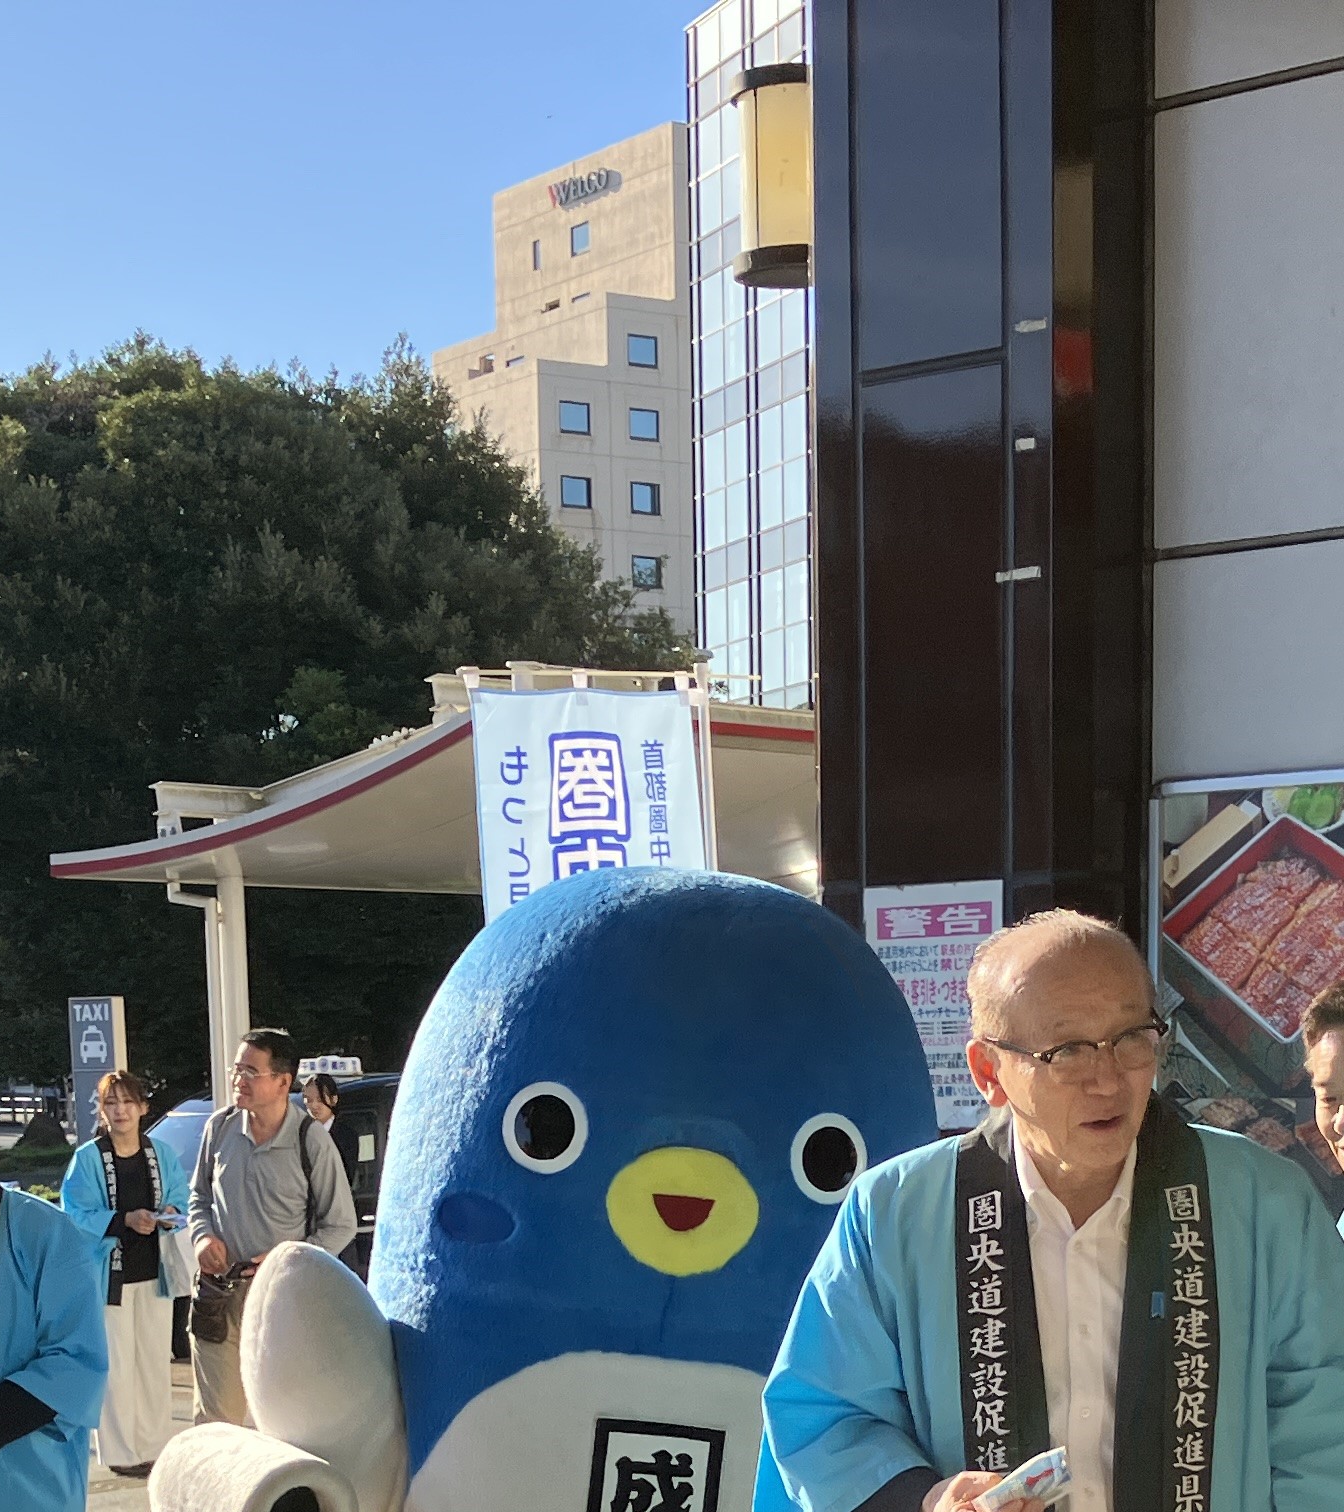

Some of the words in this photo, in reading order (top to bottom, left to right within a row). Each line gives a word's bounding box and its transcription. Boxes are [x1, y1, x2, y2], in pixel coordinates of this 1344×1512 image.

[548, 168, 608, 208] WELCO
[884, 905, 987, 938] 警告
[73, 1004, 109, 1022] TAXI
